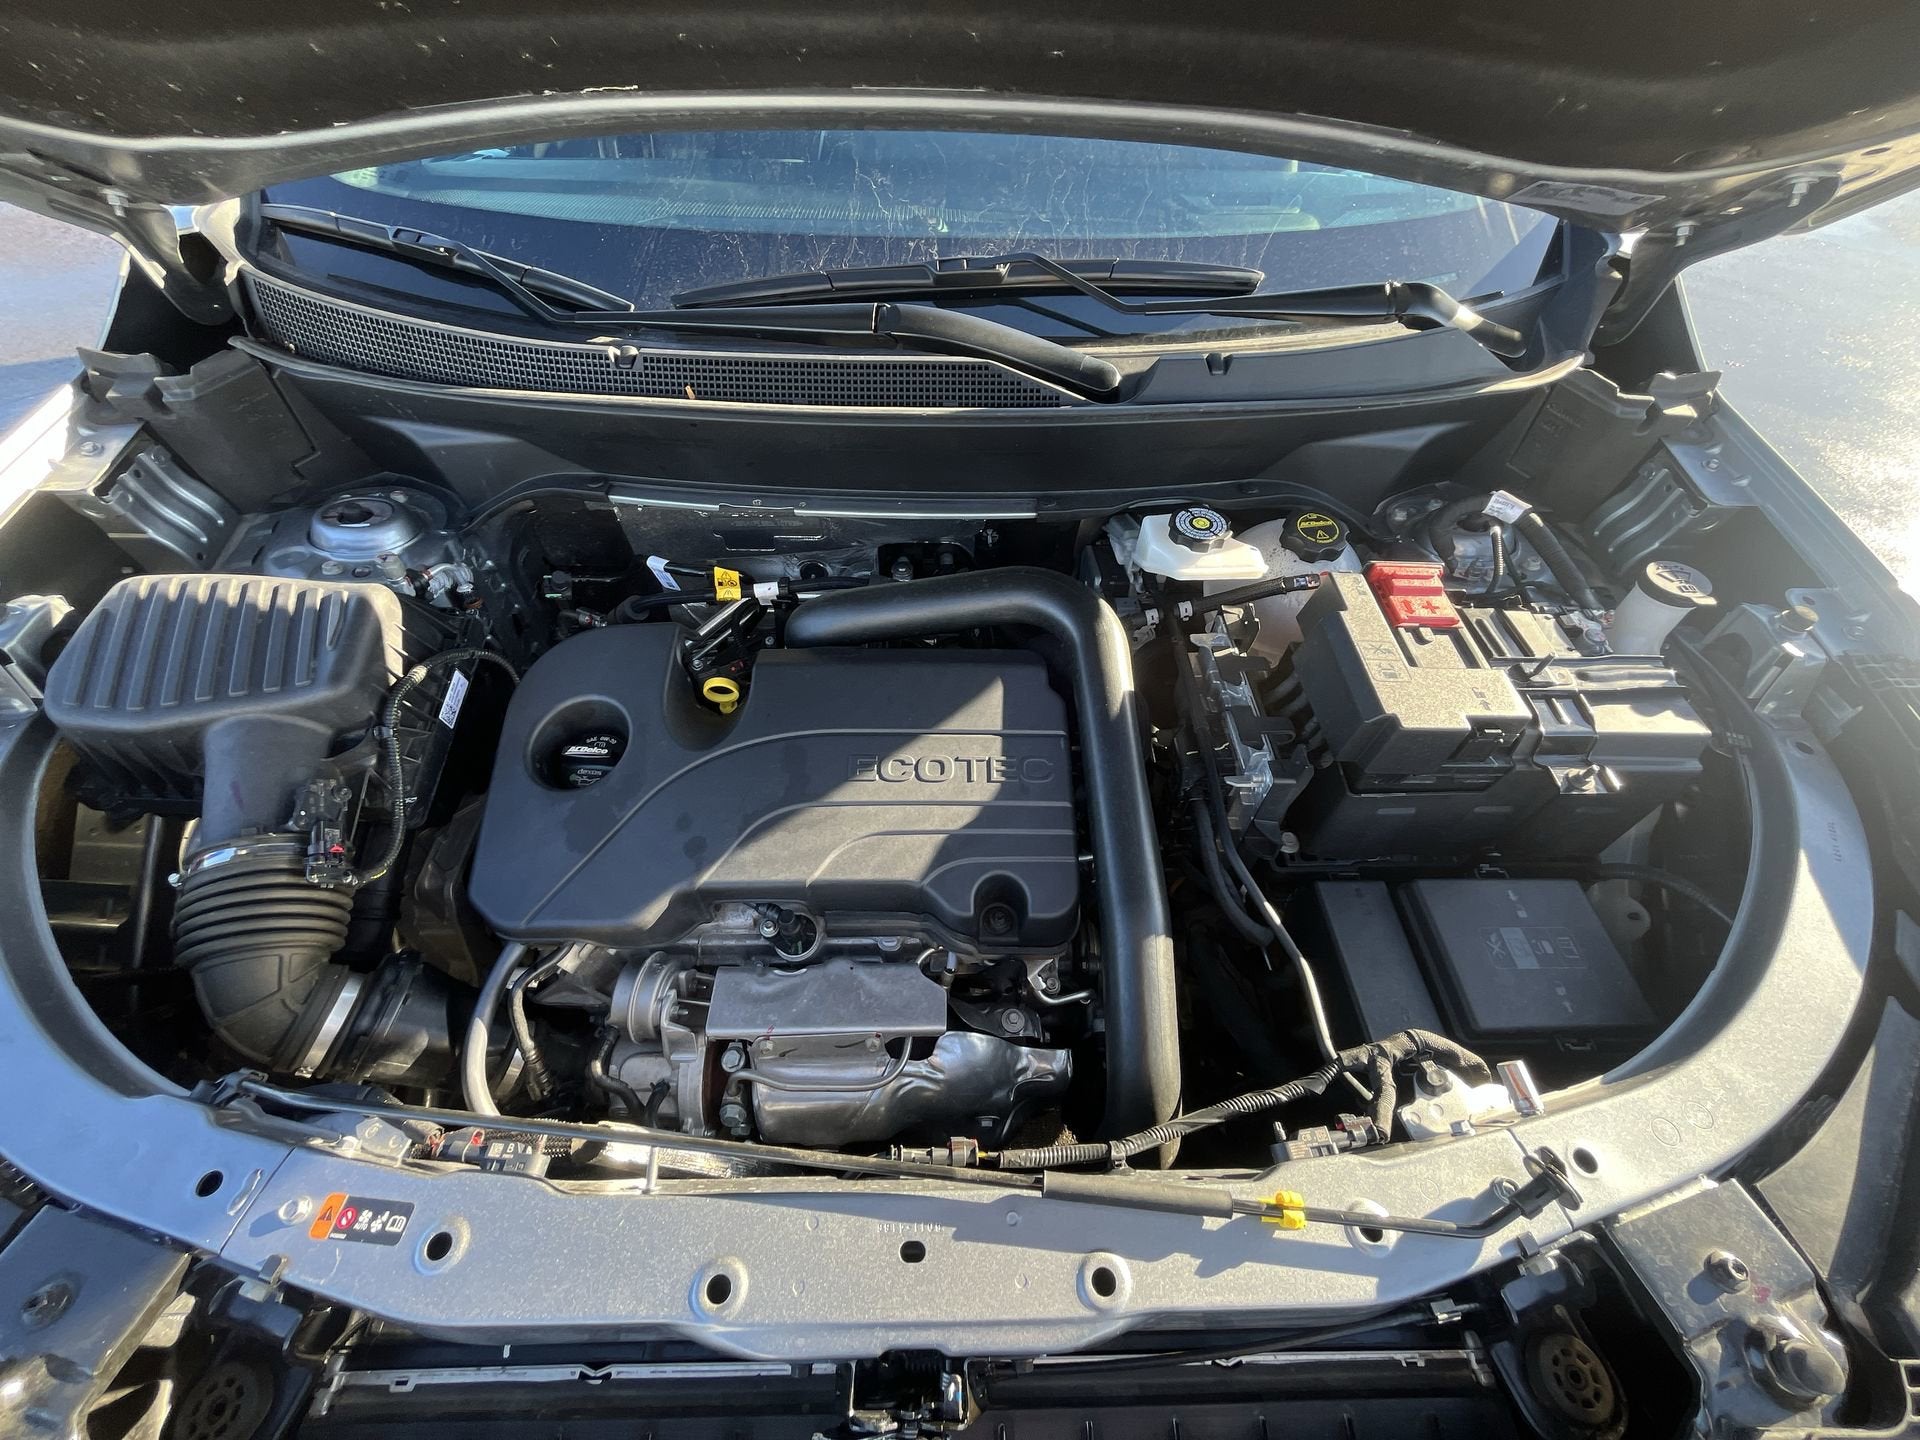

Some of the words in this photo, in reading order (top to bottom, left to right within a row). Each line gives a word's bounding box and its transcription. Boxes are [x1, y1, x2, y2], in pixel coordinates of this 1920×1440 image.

[566, 746, 609, 754] ACDelco
[848, 754, 1054, 784] ECOTEC
[353, 1222, 369, 1232] AUTO
